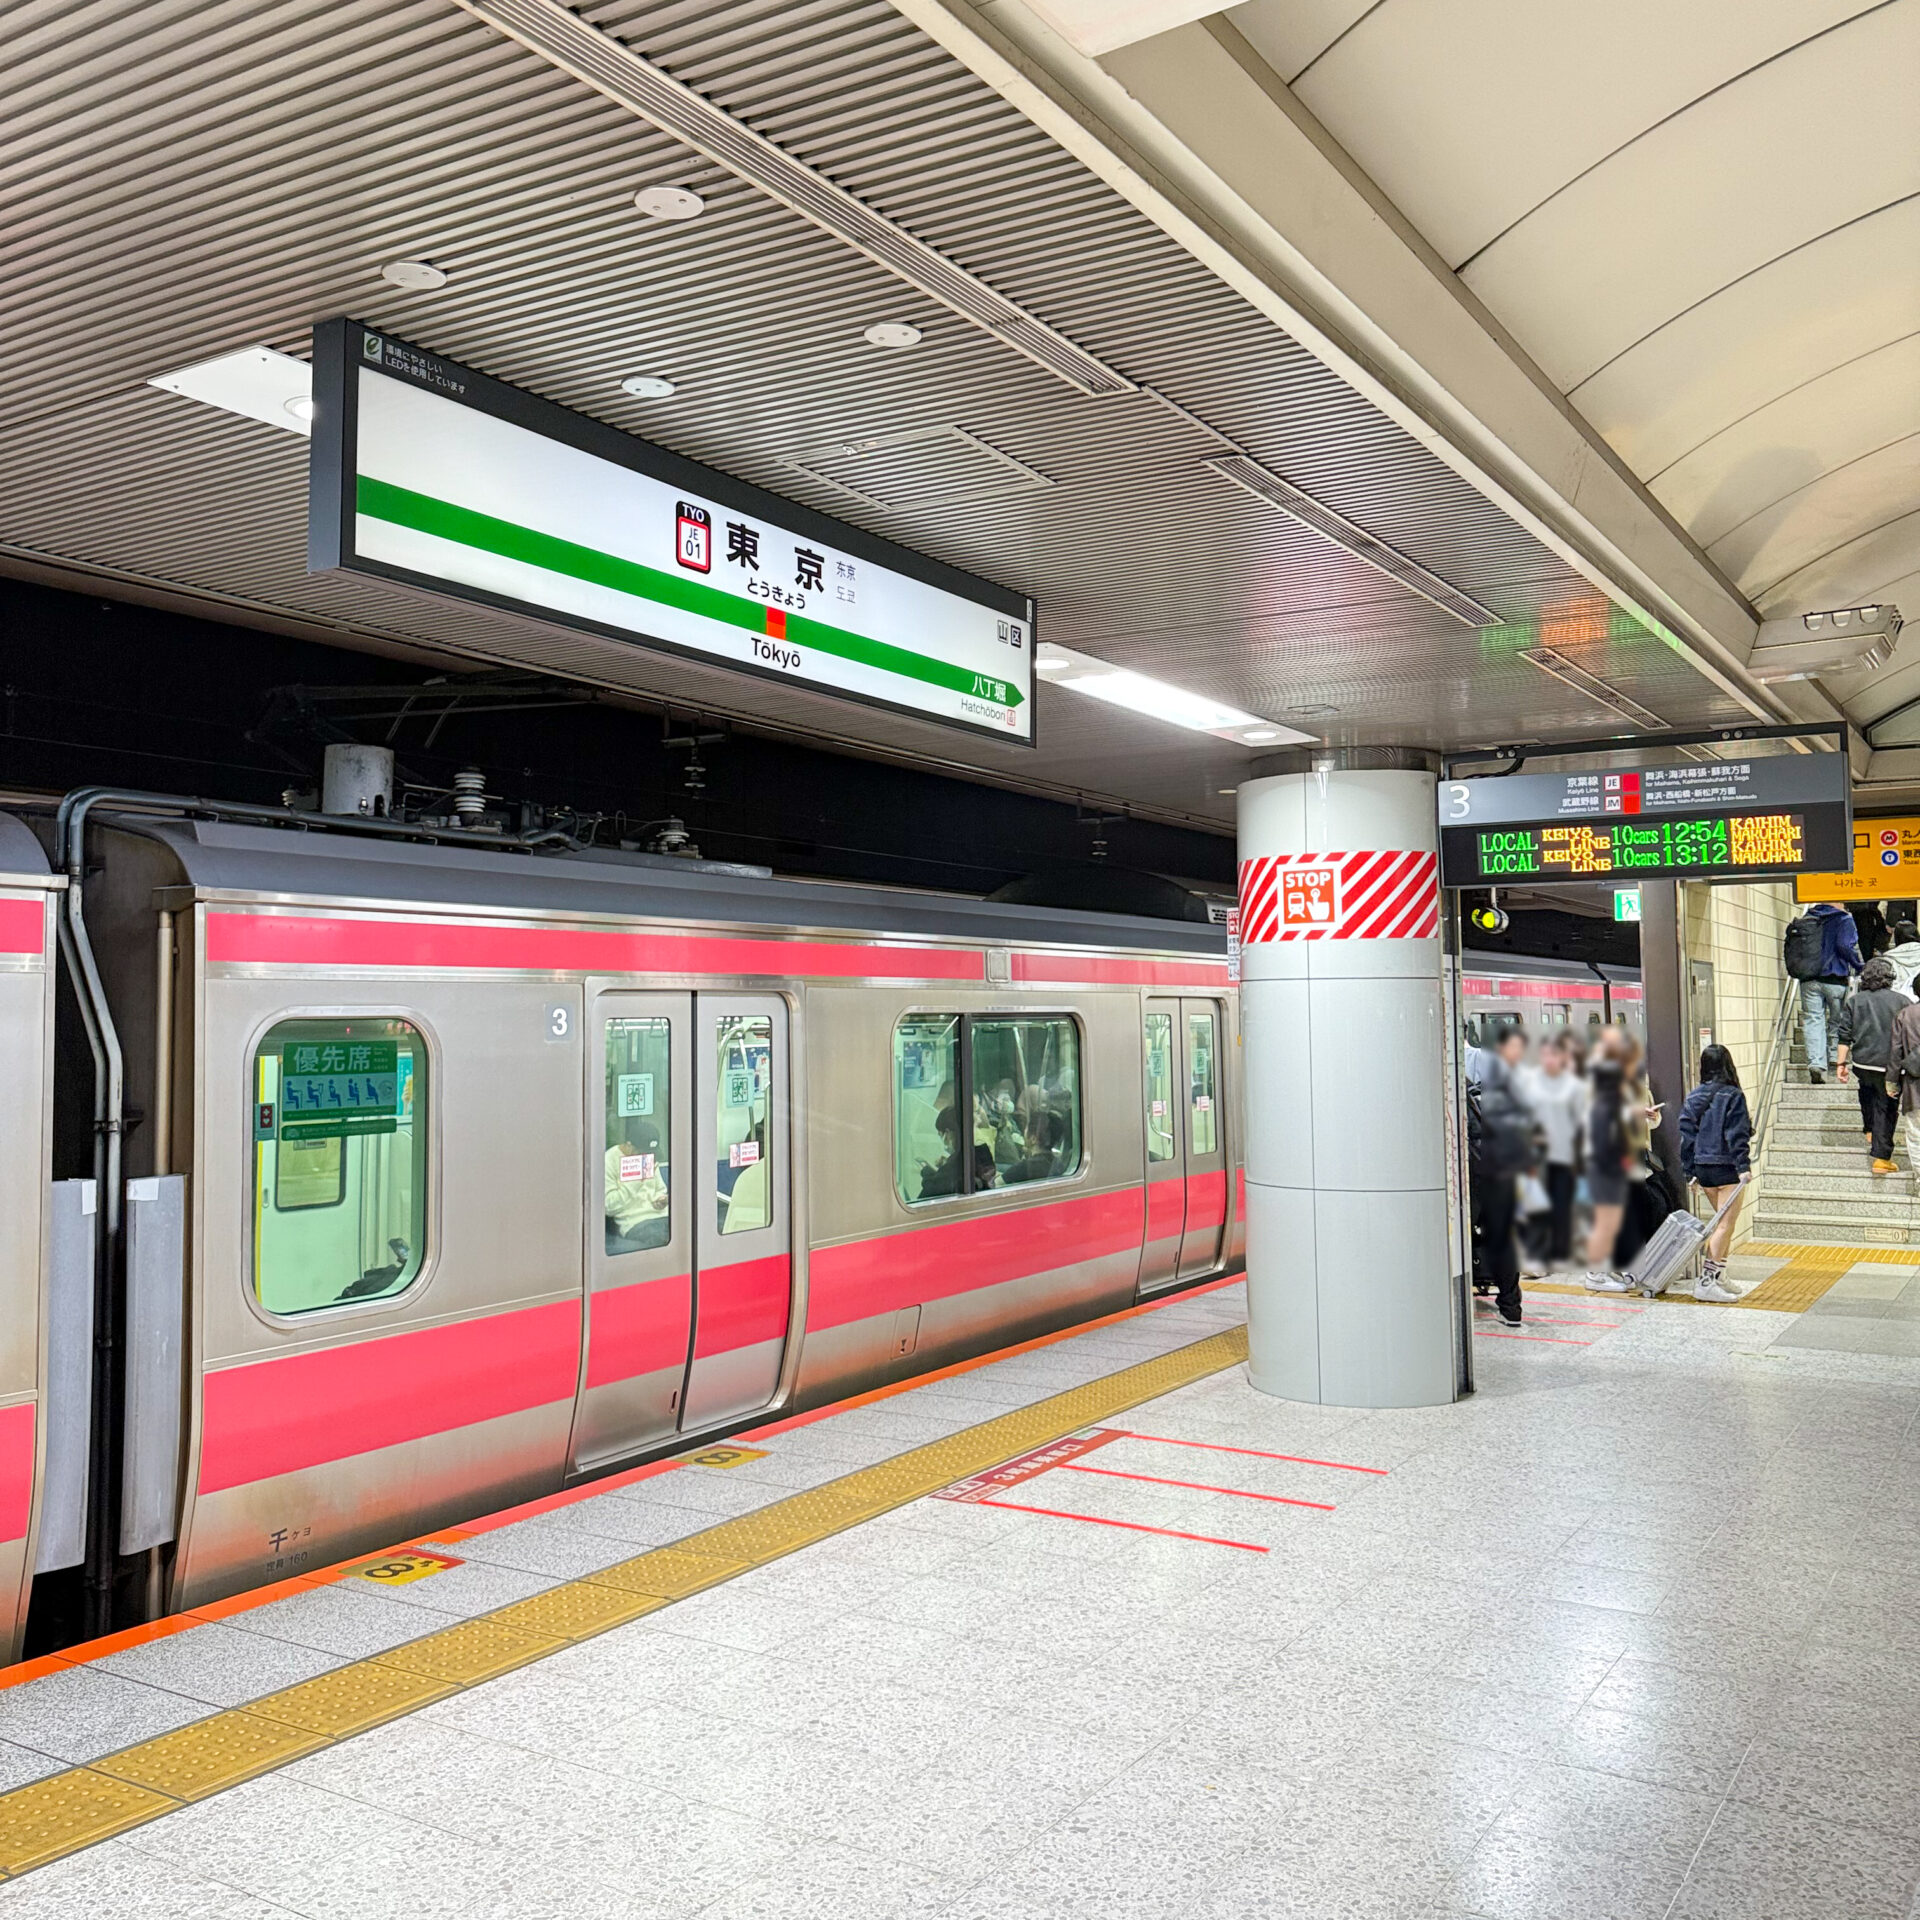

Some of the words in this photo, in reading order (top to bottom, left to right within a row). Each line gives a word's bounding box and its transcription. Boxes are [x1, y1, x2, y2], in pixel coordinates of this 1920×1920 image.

[386, 356, 466, 394] LEDを使用しています
[682, 503, 705, 523] TYO
[688, 527, 699, 541] JE
[685, 540, 700, 560] 01
[726, 521, 825, 593] 東京
[836, 561, 857, 581] 东京
[747, 577, 806, 609] とうきょう
[836, 585, 856, 604] 도쿄
[751, 637, 801, 669] Tōkyō
[972, 675, 1007, 703] 八丁堀
[1567, 775, 1599, 788] 京葉線
[1608, 778, 1617, 788] JE
[1449, 785, 1471, 819] 3
[1562, 796, 1599, 807] 武蔵野線
[1608, 799, 1619, 808] JM
[1481, 832, 1539, 853] LOCAL
[1662, 820, 1727, 844] 12:54
[1569, 836, 1611, 850] LINE
[1731, 826, 1802, 842] MAKUHARI
[1483, 853, 1540, 873] LOCAL
[1663, 843, 1728, 866] 13:12
[1571, 858, 1612, 872] LINE
[1732, 849, 1802, 865] MAKUHARI
[1286, 871, 1331, 888] STOP
[1834, 878, 1864, 888] 나가는
[1868, 877, 1878, 887] 곳
[552, 1007, 568, 1036] 3
[293, 1045, 372, 1073] 優先席
[290, 1551, 308, 1566] 160
[365, 1563, 415, 1578] 8
